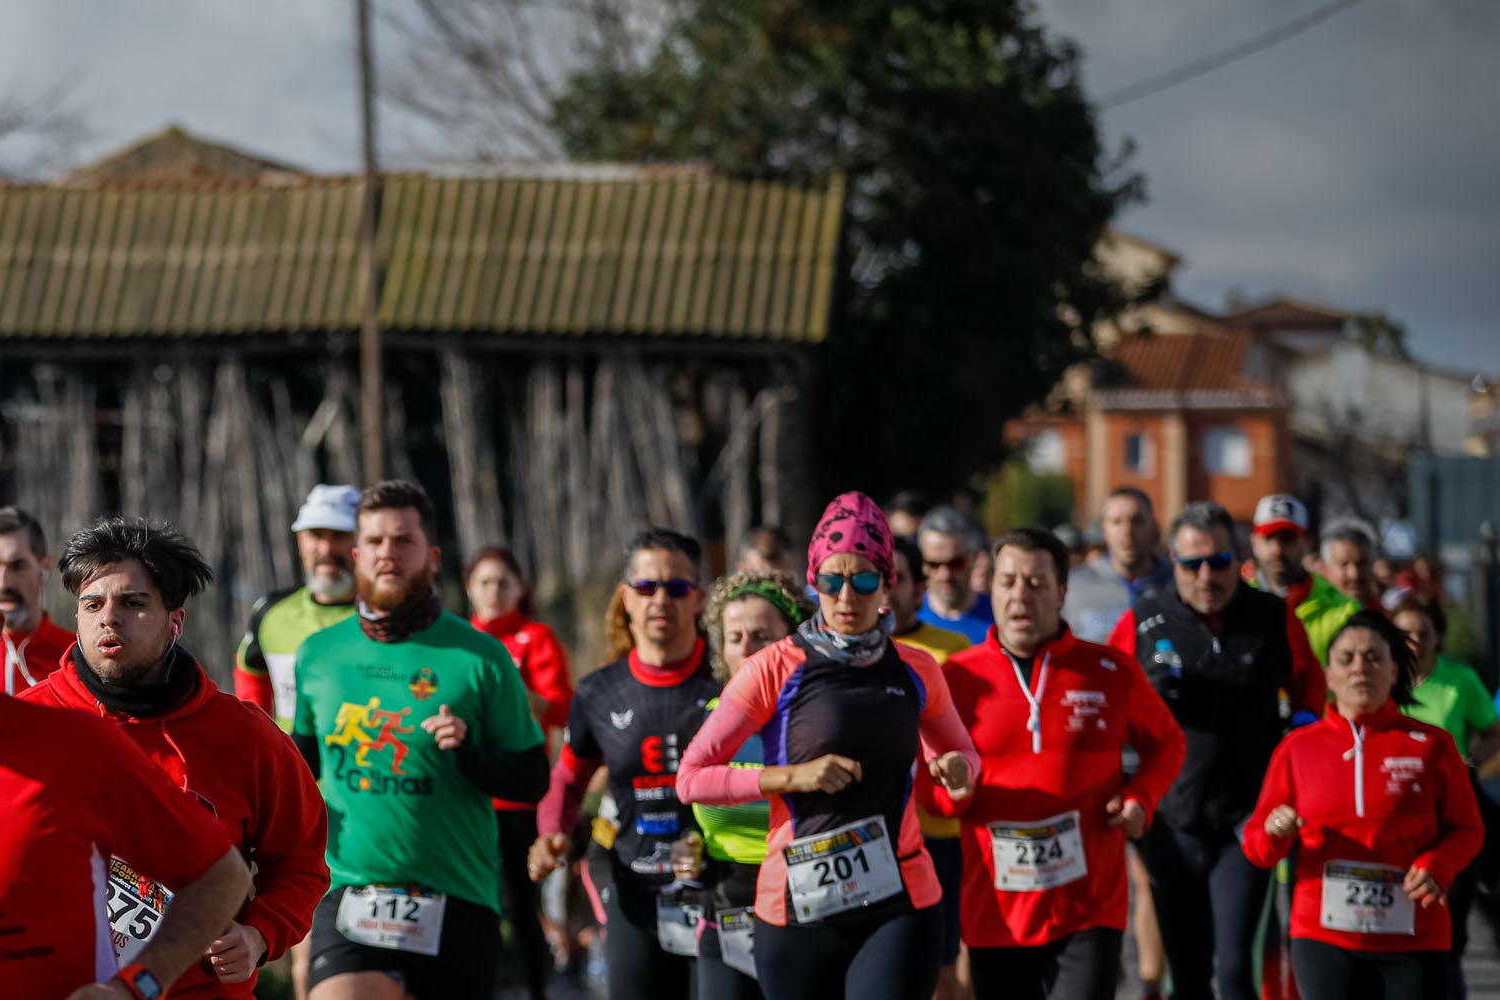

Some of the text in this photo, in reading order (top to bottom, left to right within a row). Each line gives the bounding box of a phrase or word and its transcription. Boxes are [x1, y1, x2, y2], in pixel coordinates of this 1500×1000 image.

[1016, 837, 1064, 865] 224
[813, 848, 870, 887] 201
[1346, 882, 1395, 908] 225
[368, 896, 420, 922] 112
